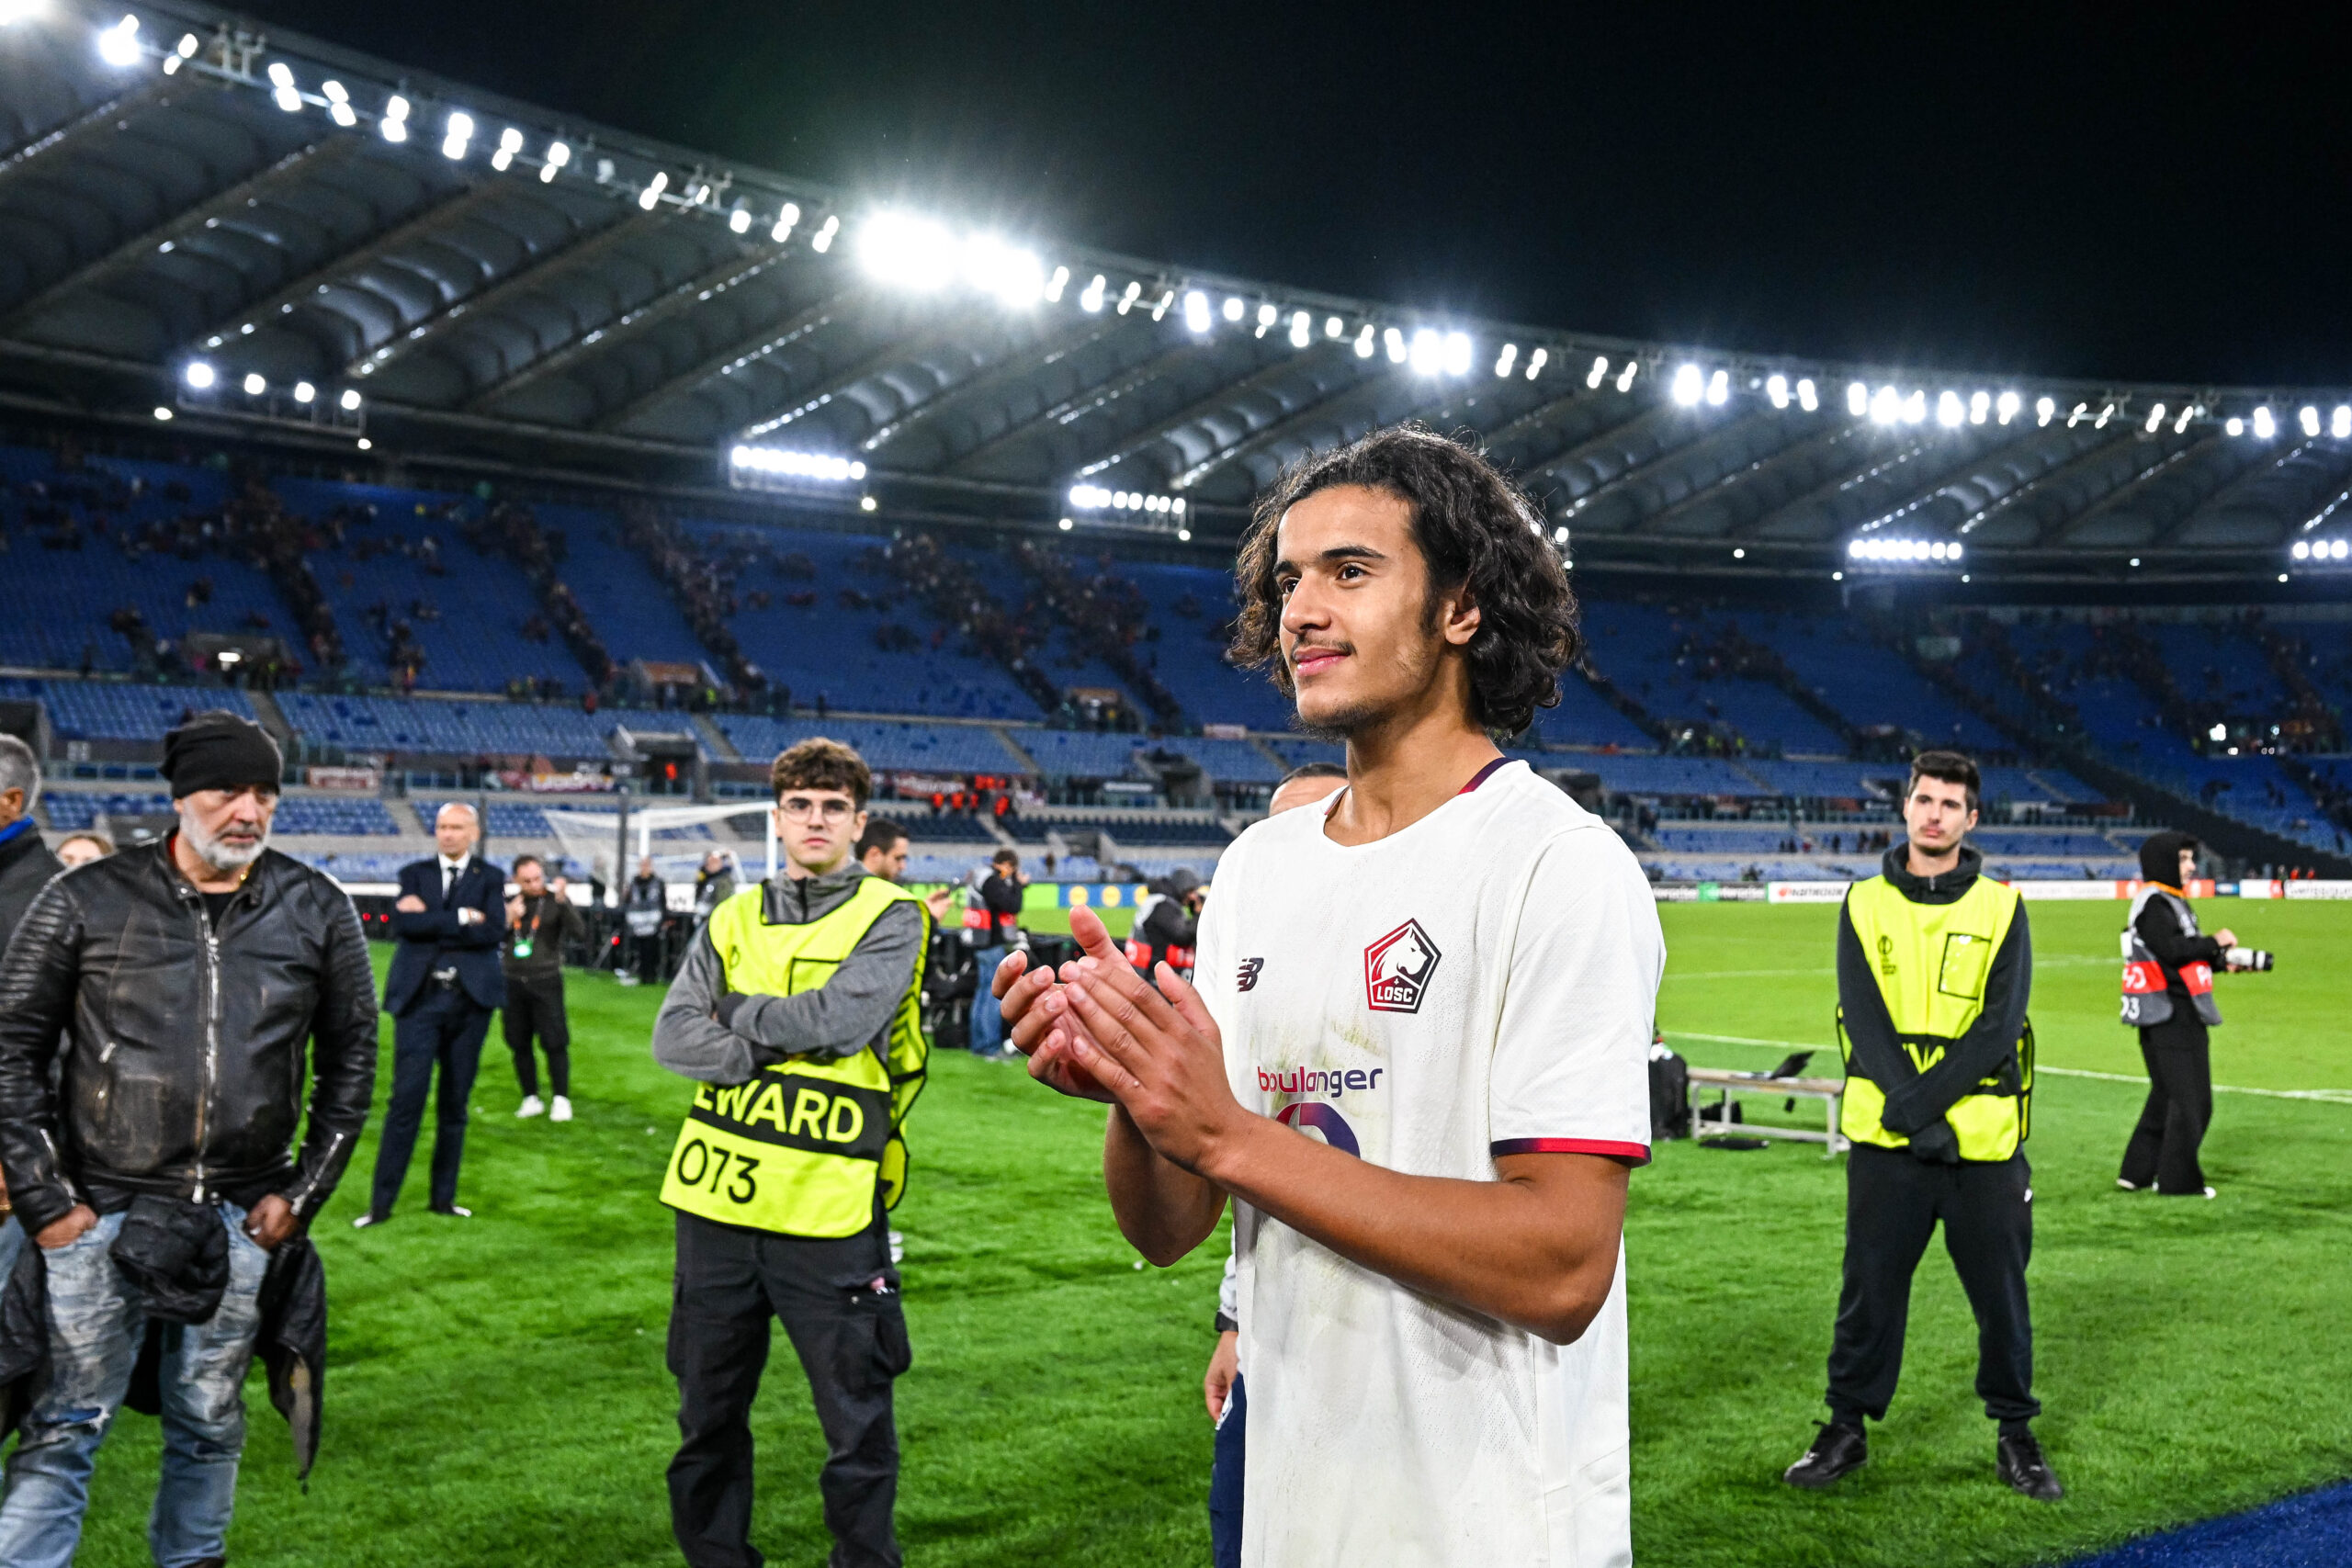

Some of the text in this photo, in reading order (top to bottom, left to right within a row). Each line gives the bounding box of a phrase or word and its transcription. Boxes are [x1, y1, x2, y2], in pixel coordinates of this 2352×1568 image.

[1376, 986, 1414, 1002] LOSC
[1257, 1066, 1384, 1098] boulanger
[677, 1138, 760, 1203] 073
